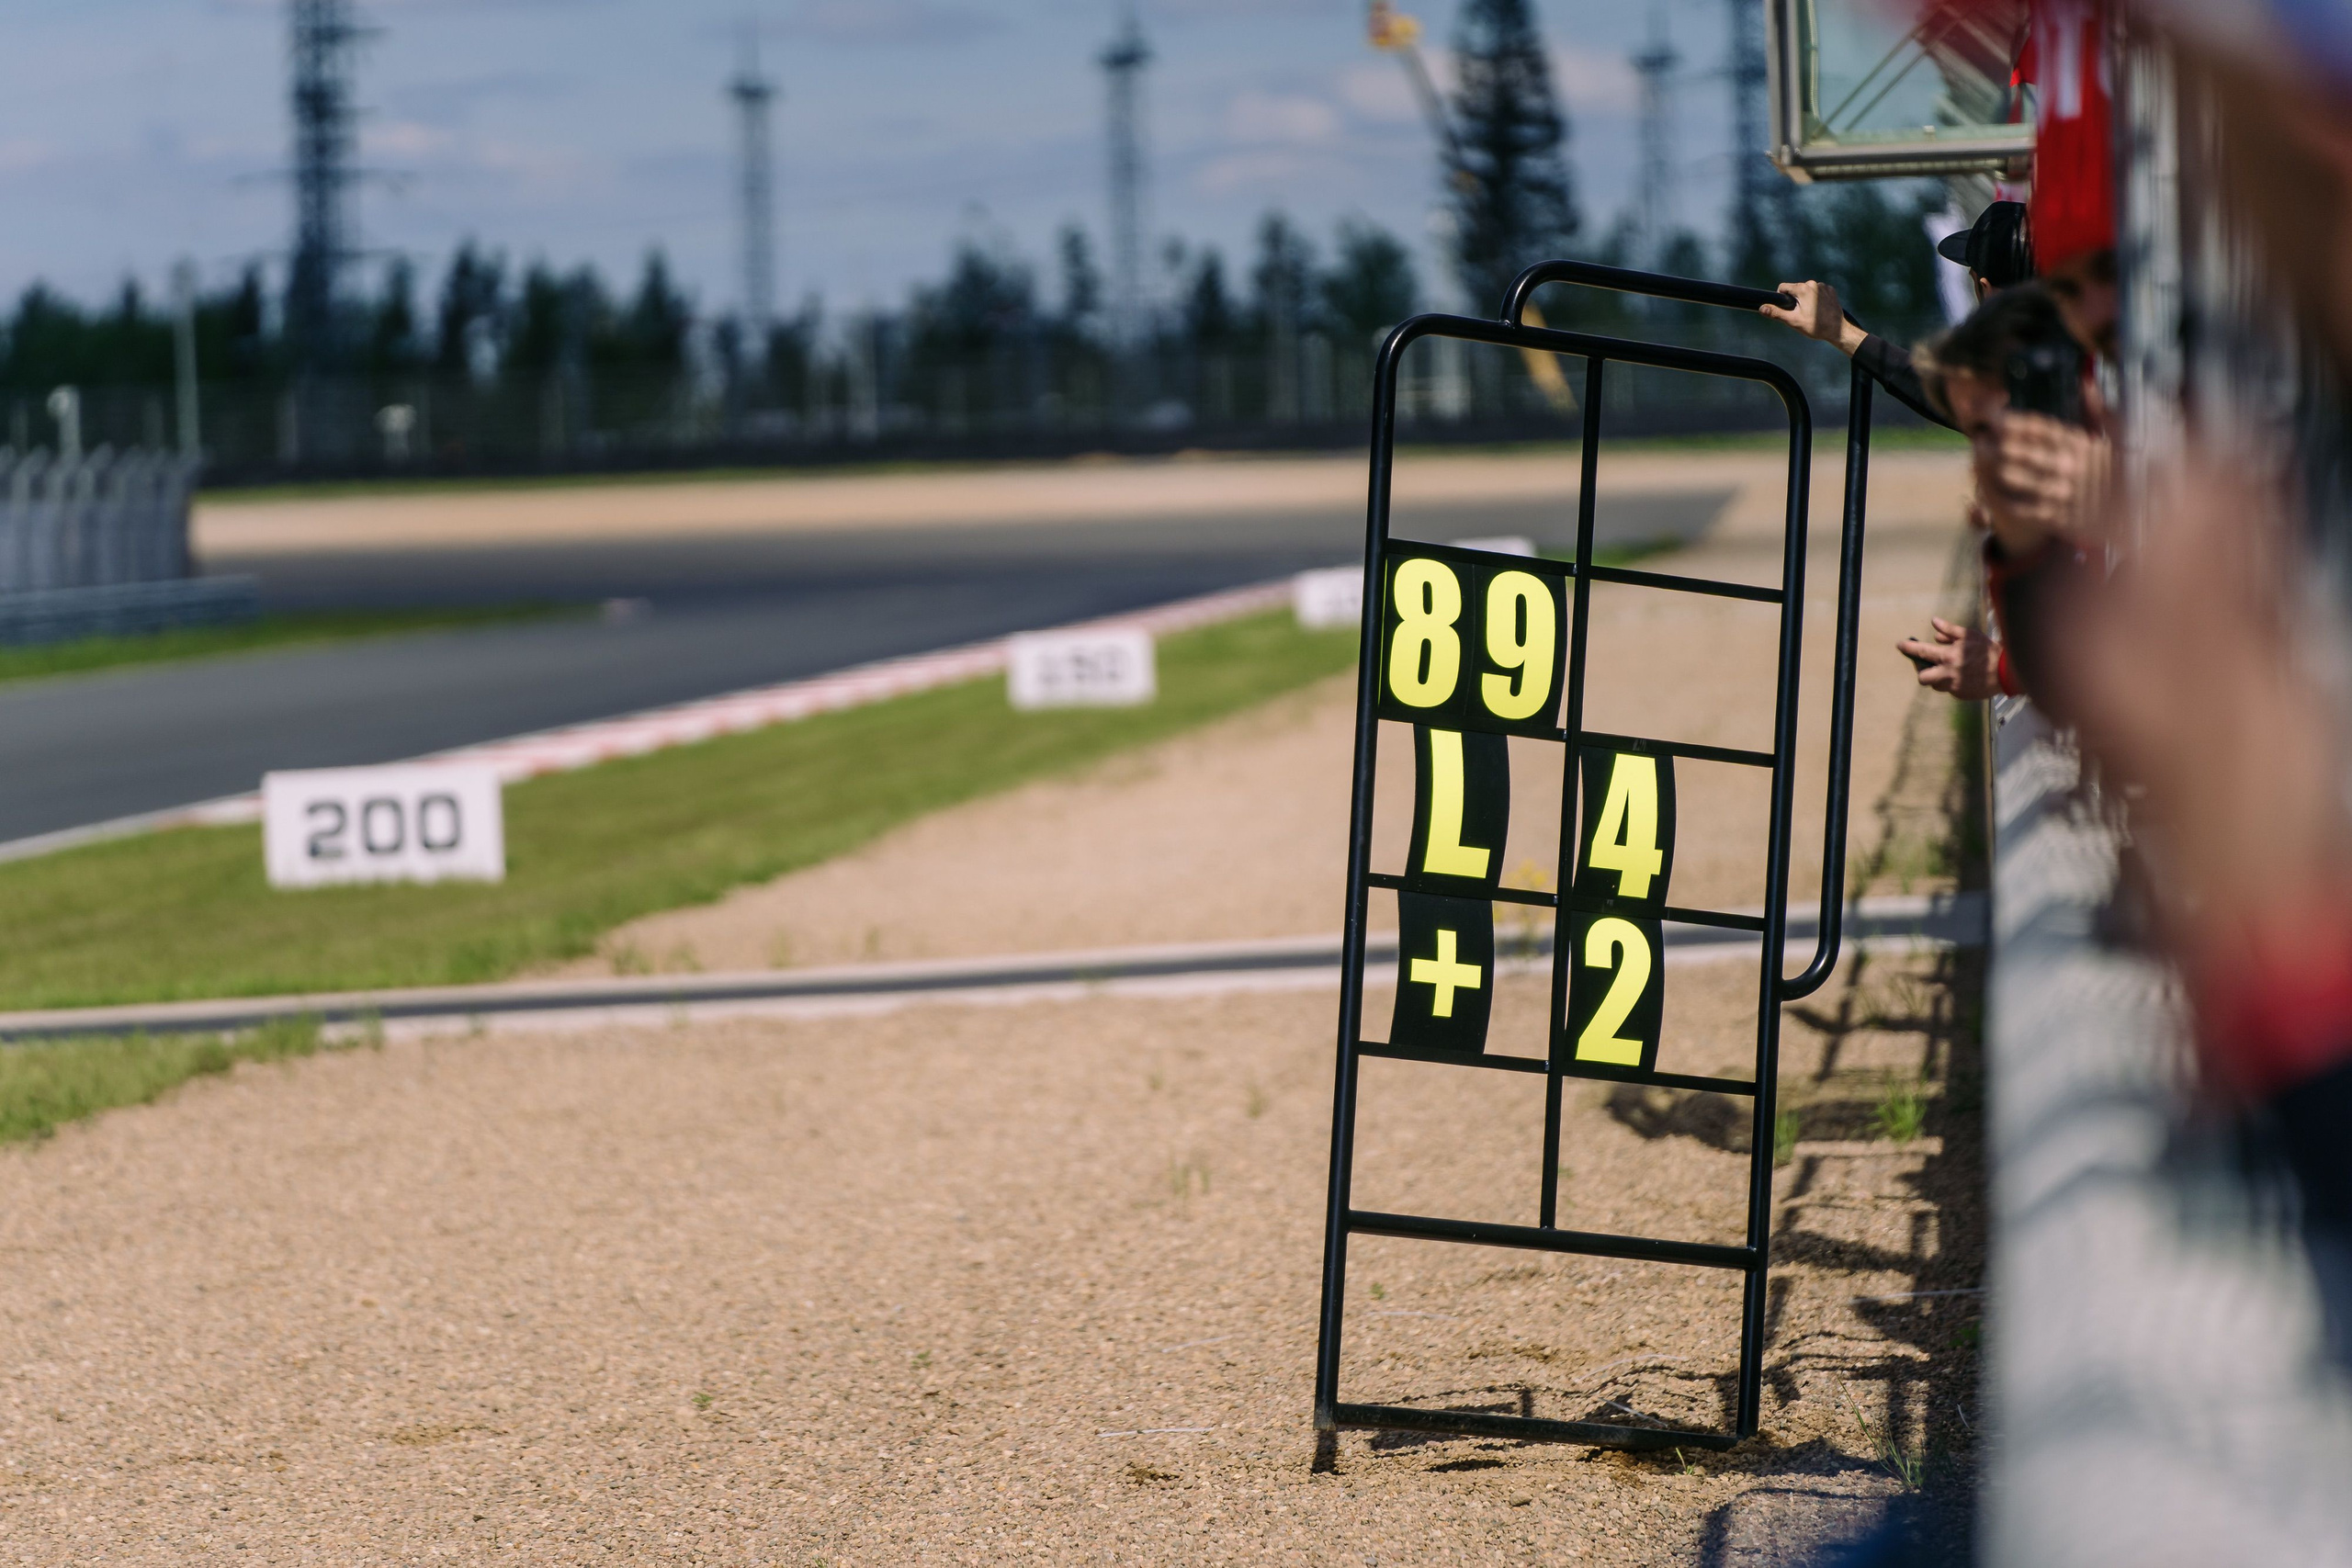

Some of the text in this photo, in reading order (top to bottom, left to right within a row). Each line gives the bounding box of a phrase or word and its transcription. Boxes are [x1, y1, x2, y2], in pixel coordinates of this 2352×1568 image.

[1389, 558, 1556, 719] 89
[304, 793, 462, 860] 200
[1423, 729, 1663, 899] L 4
[1575, 918, 1652, 1066] 2
